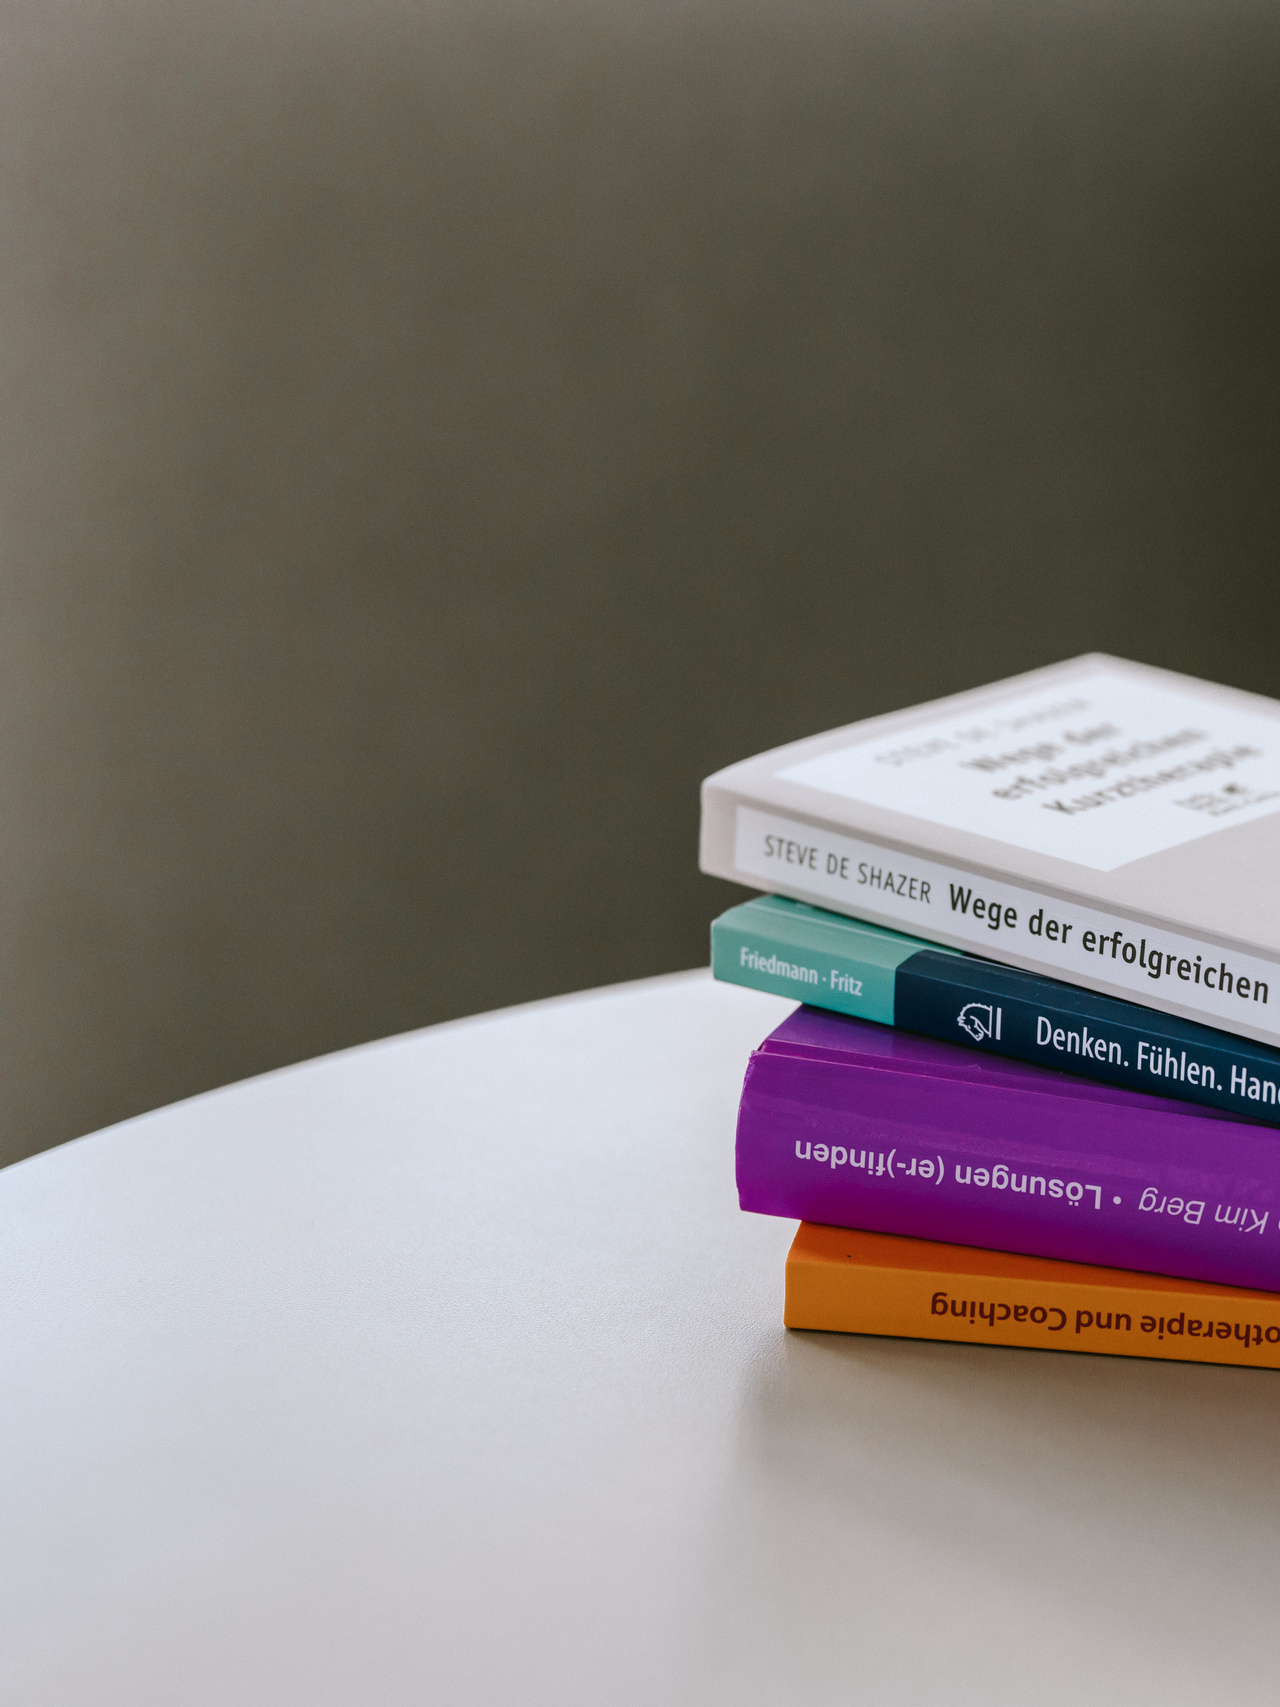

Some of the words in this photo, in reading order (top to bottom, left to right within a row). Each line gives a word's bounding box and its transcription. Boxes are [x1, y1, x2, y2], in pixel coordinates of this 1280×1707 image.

[763, 833, 818, 870] STEVE
[826, 852, 850, 879] DE
[857, 862, 931, 903] SHAZER
[949, 883, 1018, 930] Wege
[1028, 908, 1073, 944] der
[1082, 930, 1269, 1004] erfolgreichen
[740, 947, 818, 985] Friedmann
[830, 970, 863, 997] Fritz
[1036, 1016, 1129, 1067] Denken.
[1137, 1041, 1223, 1091] Fühlen.
[795, 1140, 945, 1185] (er-)finden
[954, 1164, 1102, 1210] Lösungen
[1139, 1187, 1205, 1225] Berg
[1214, 1203, 1269, 1235] Kim
[930, 1291, 1067, 1332] Coaching
[1075, 1309, 1132, 1333] und
